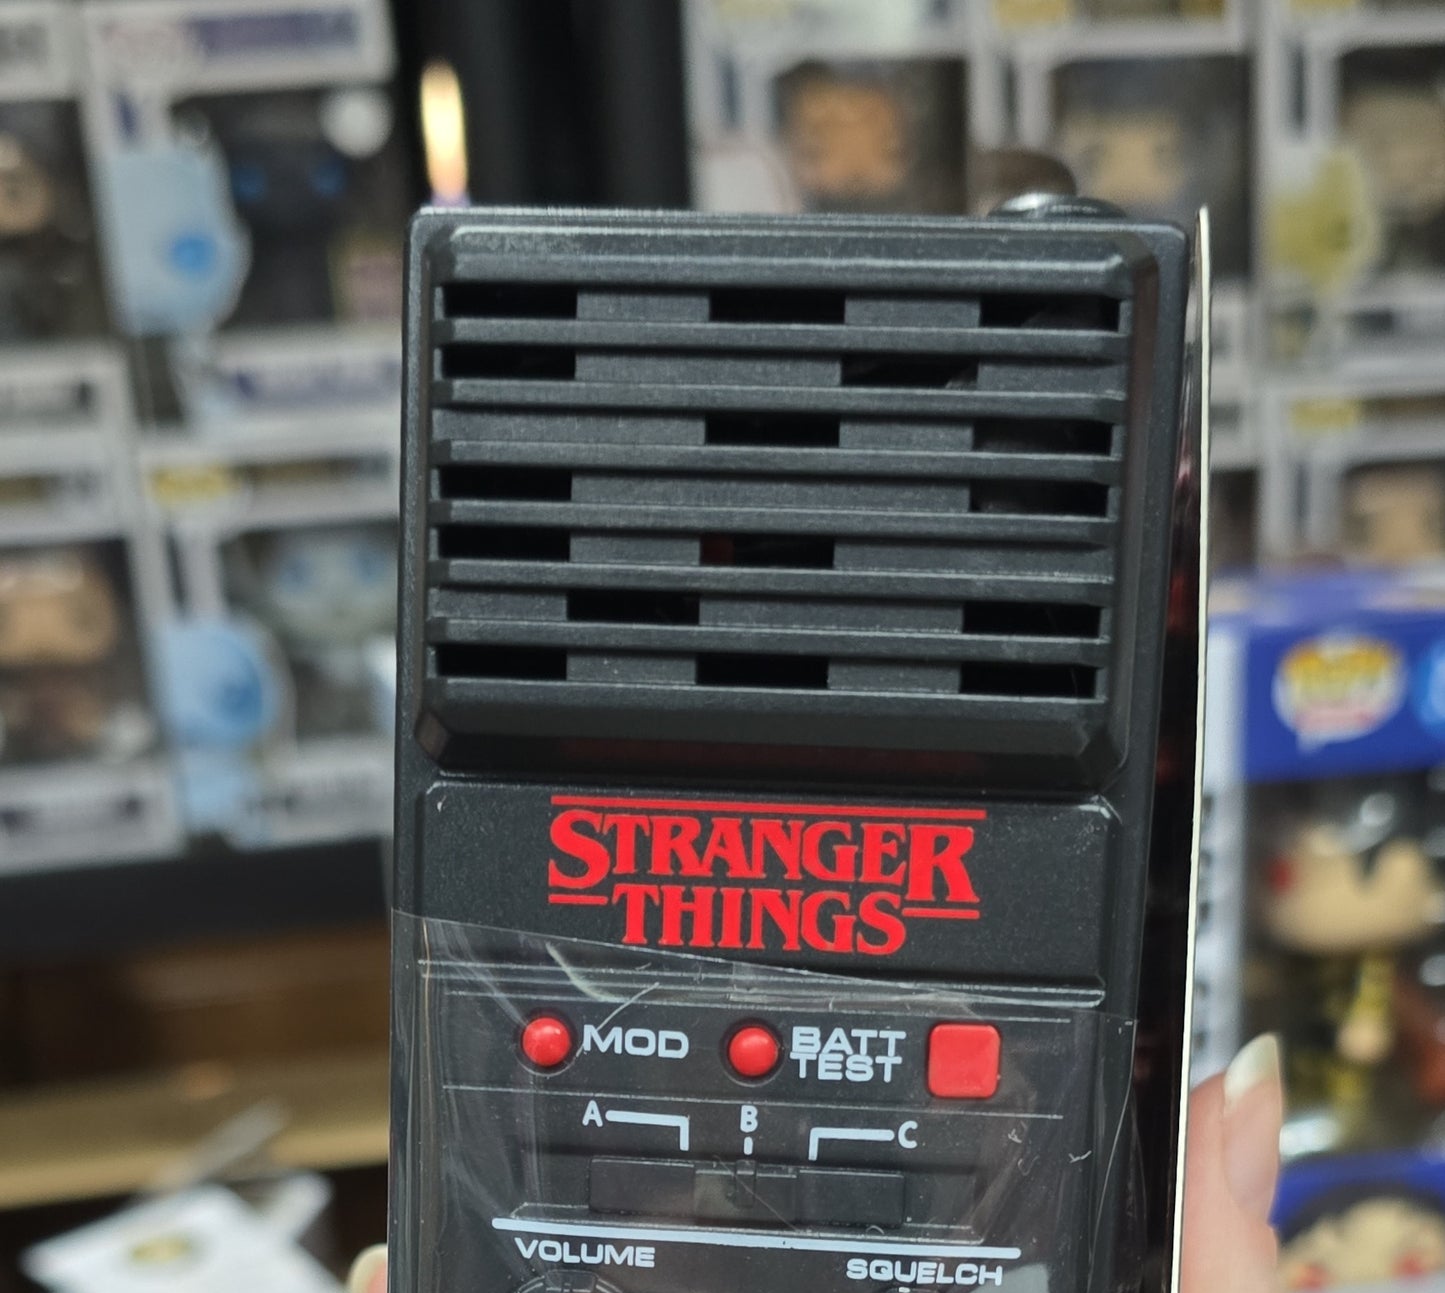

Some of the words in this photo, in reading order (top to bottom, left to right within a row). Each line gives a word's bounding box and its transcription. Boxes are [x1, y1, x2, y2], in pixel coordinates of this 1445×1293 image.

[548, 809, 981, 903] STRANGER
[612, 883, 906, 955] THINGS
[582, 1024, 690, 1059] MOD
[791, 1025, 907, 1058] BATT
[789, 1053, 903, 1083] TEST
[580, 1099, 604, 1127] A
[739, 1104, 760, 1134] B
[896, 1119, 919, 1150] C
[514, 1237, 656, 1268] VOLUME
[845, 1257, 1004, 1287] SQUELCH
